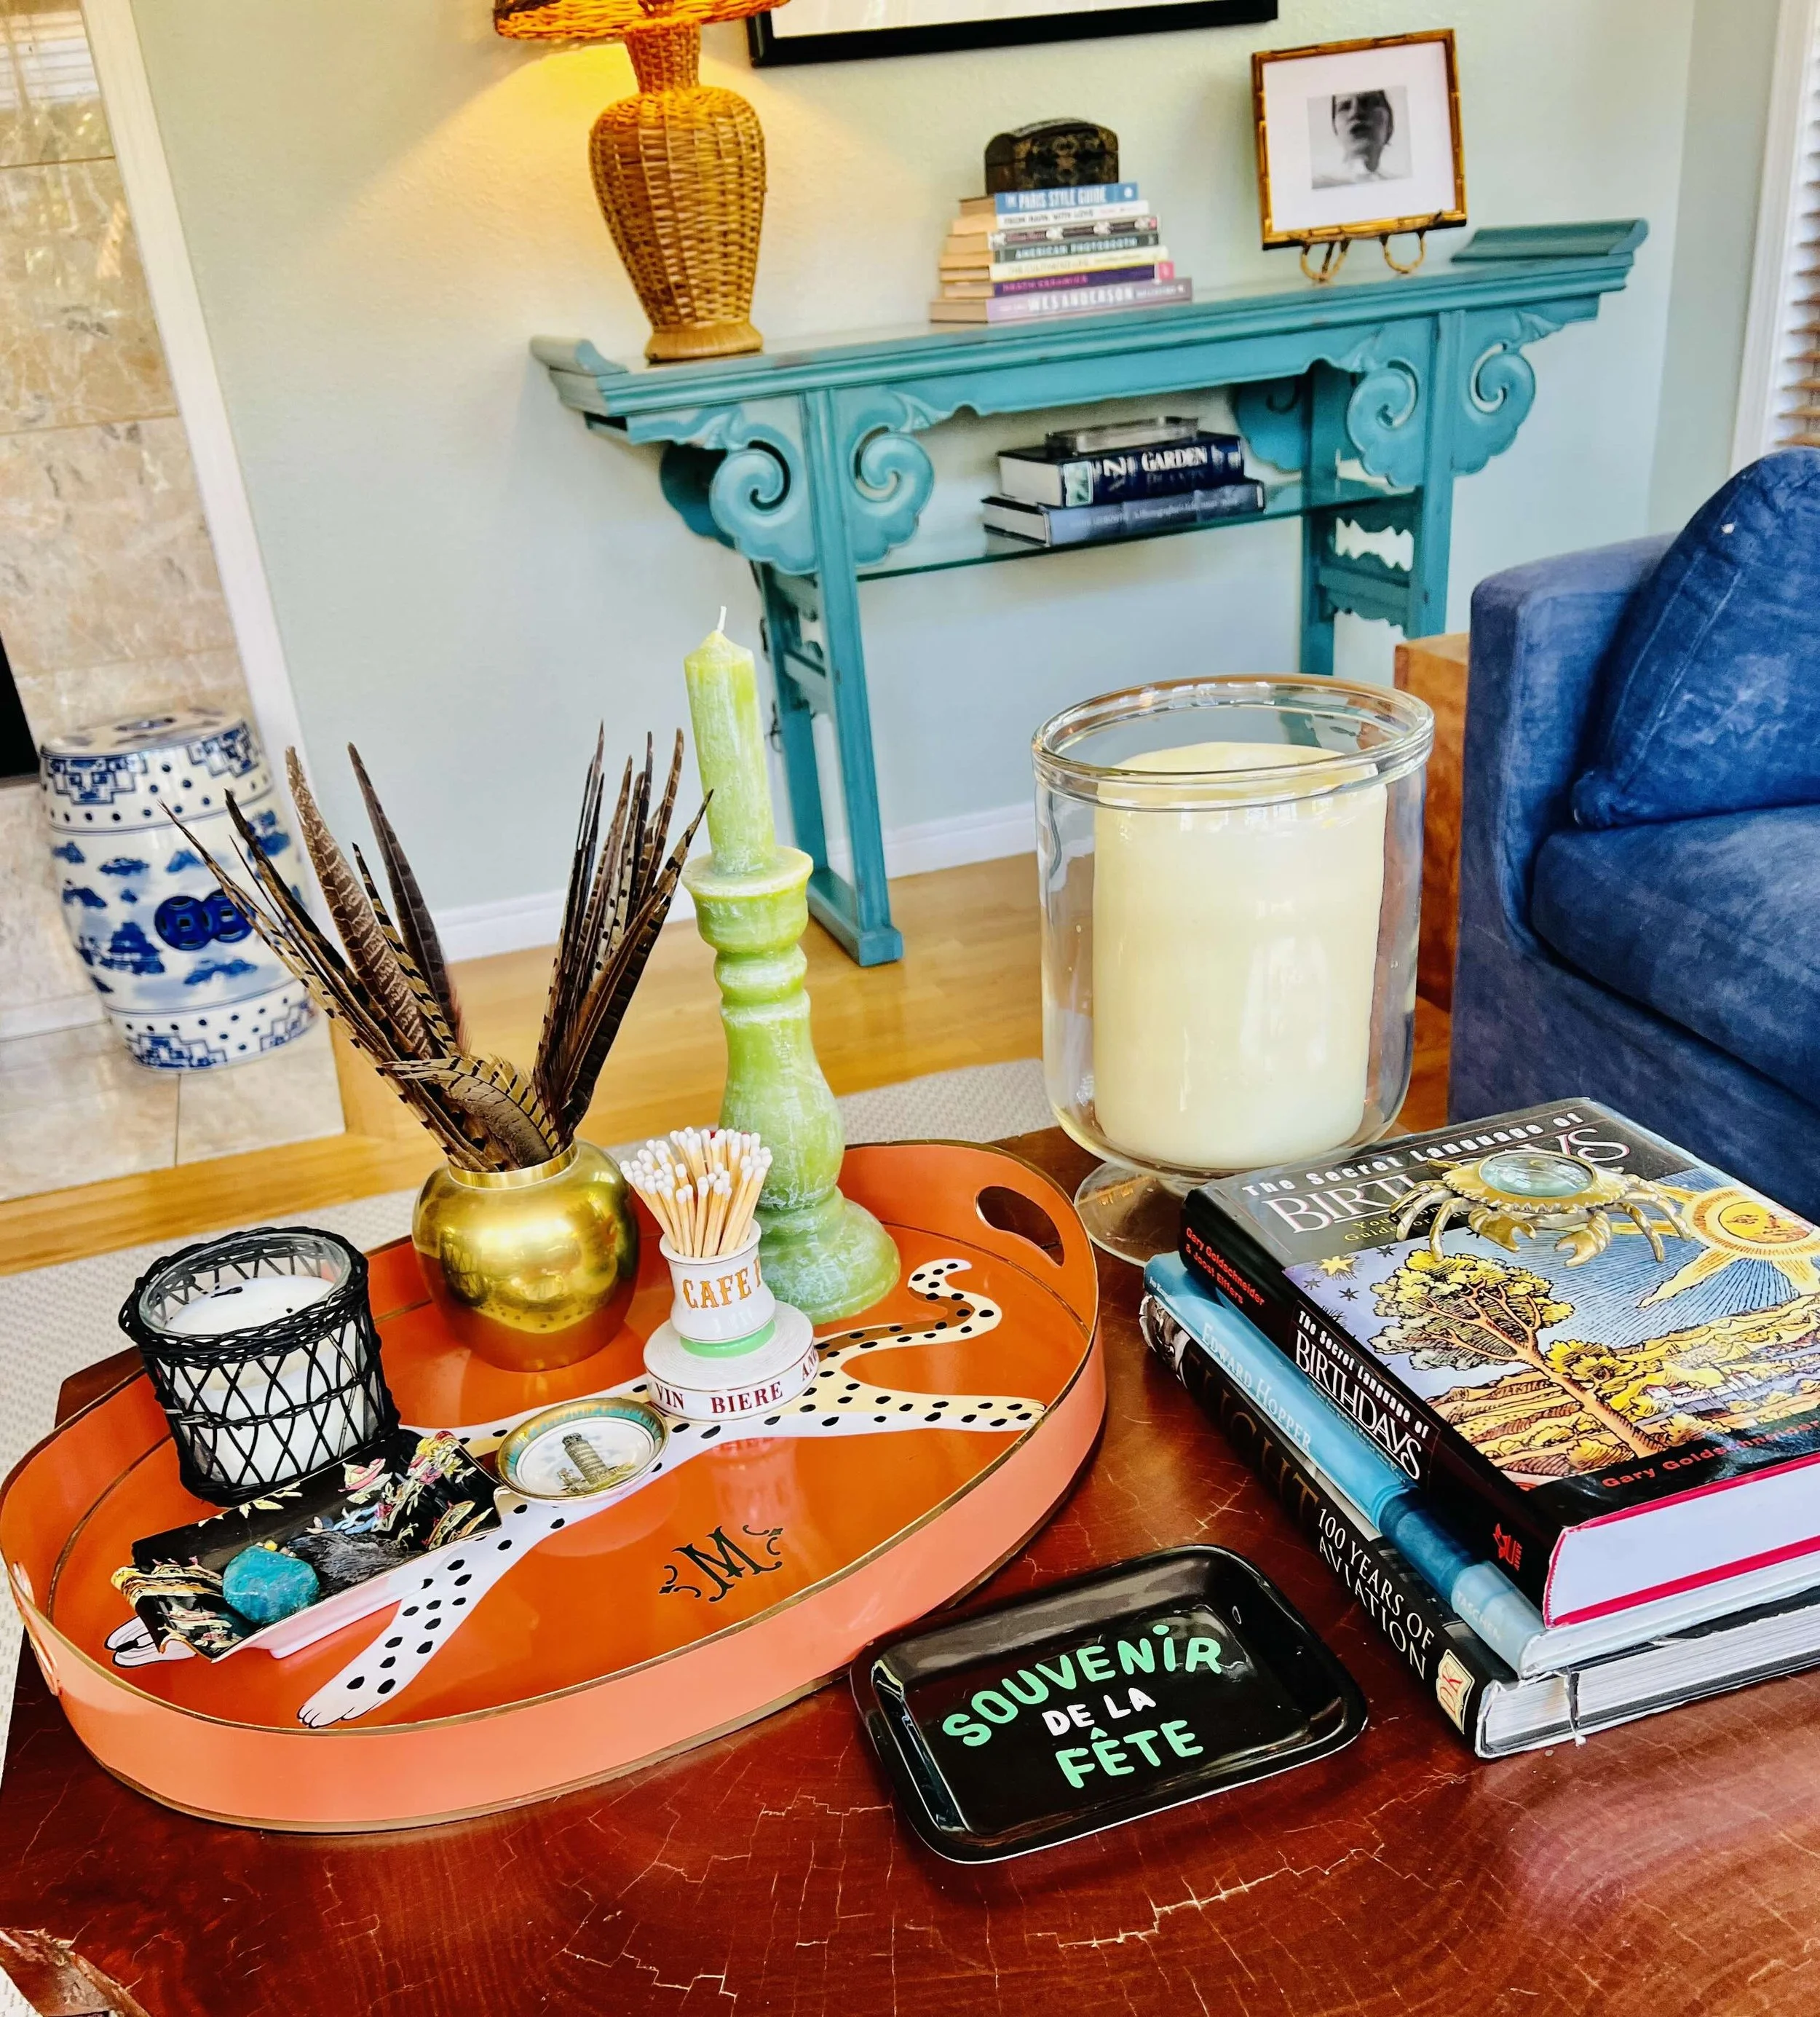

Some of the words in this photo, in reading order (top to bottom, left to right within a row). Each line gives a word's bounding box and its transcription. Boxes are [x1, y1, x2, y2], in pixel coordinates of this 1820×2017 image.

[1019, 191, 1047, 210] PARIS
[1048, 189, 1076, 208] STYLE
[1078, 186, 1106, 205] GUIDE
[1015, 245, 1068, 259] AMERICAN
[1070, 237, 1137, 255] PHOTOBOOTH
[1028, 293, 1059, 312] WES
[1061, 286, 1133, 309] ANDERSON
[1241, 1180, 1297, 1196] The
[1305, 1156, 1404, 1185] Secret
[1409, 1124, 1544, 1163] Language
[1552, 1112, 1584, 1128] of
[683, 1266, 752, 1309] CAFE
[1186, 1227, 1205, 1251] Gary
[1206, 1246, 1265, 1306] Goldschneider
[654, 1382, 685, 1410] VIN
[711, 1381, 784, 1414] BIERE
[1295, 1329, 1422, 1480] BIRTHDAYS
[1299, 1310, 1316, 1335] The
[1319, 1330, 1355, 1371] Secret
[1357, 1365, 1411, 1423] Language
[1415, 1420, 1429, 1440] of
[1602, 1467, 1656, 1488] Gary
[1318, 1509, 1346, 1550] 100
[1349, 1540, 1405, 1617] YEARS
[1406, 1612, 1436, 1651] OF
[1319, 1536, 1427, 1681] AVIATION
[1042, 1703, 1095, 1737] DE
[1102, 1686, 1158, 1717] LA
[1055, 1719, 1204, 1789] FÊTE
